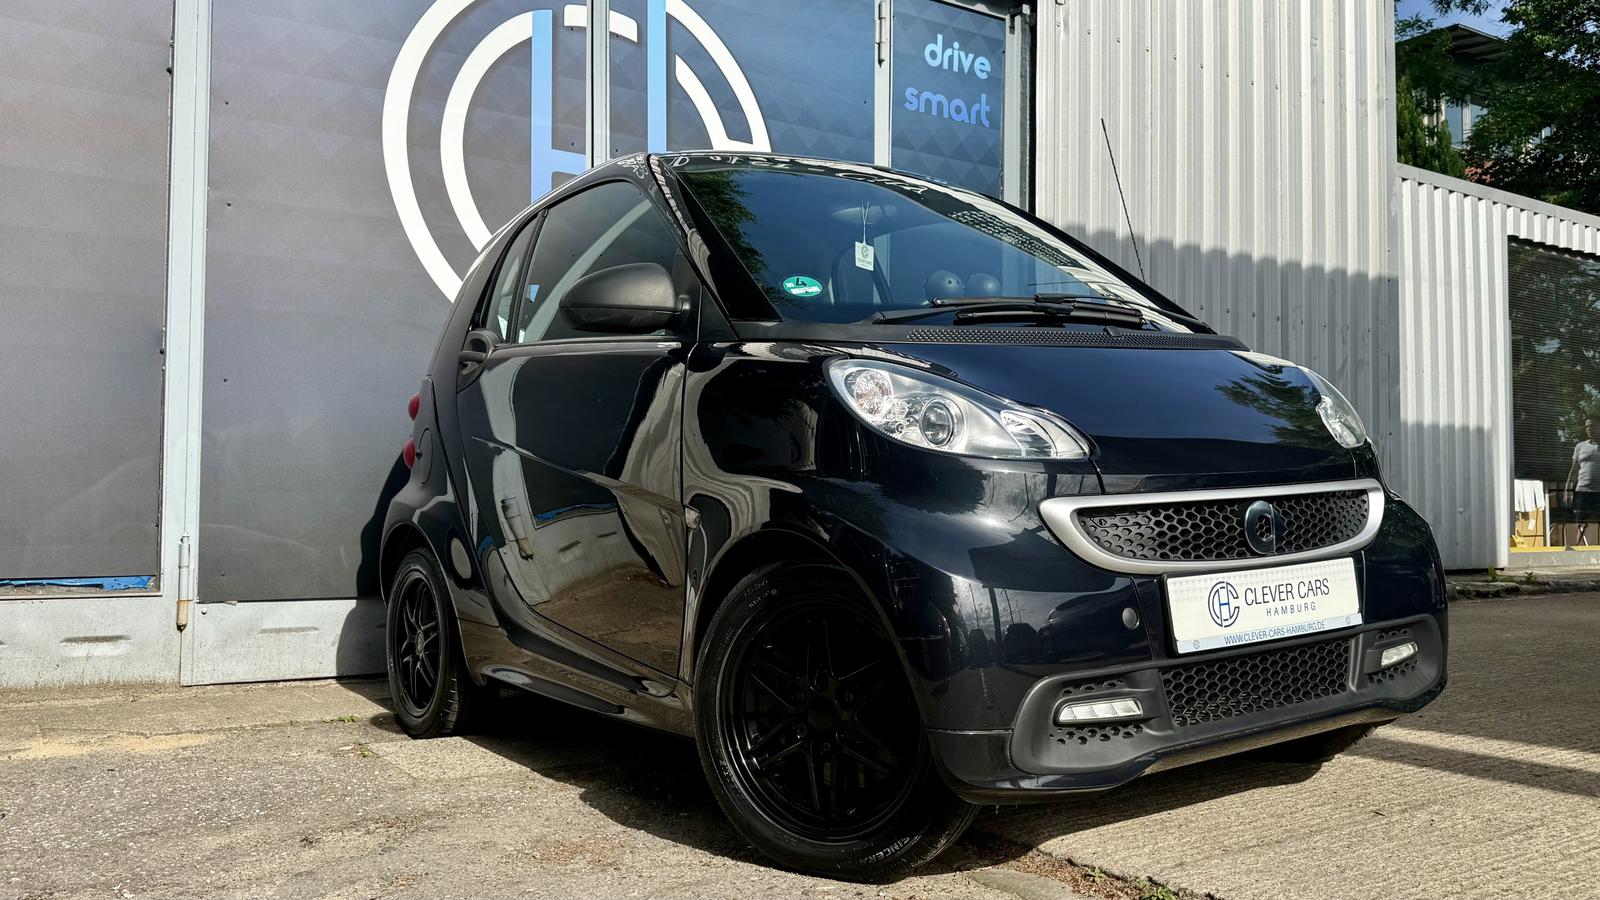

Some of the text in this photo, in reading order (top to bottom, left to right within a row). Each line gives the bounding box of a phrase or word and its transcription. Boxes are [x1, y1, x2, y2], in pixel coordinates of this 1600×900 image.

[924, 33, 991, 80] drive
[903, 86, 991, 128] smart
[1244, 577, 1330, 606] CLEVER CARS
[1266, 601, 1317, 617] HAMBURG
